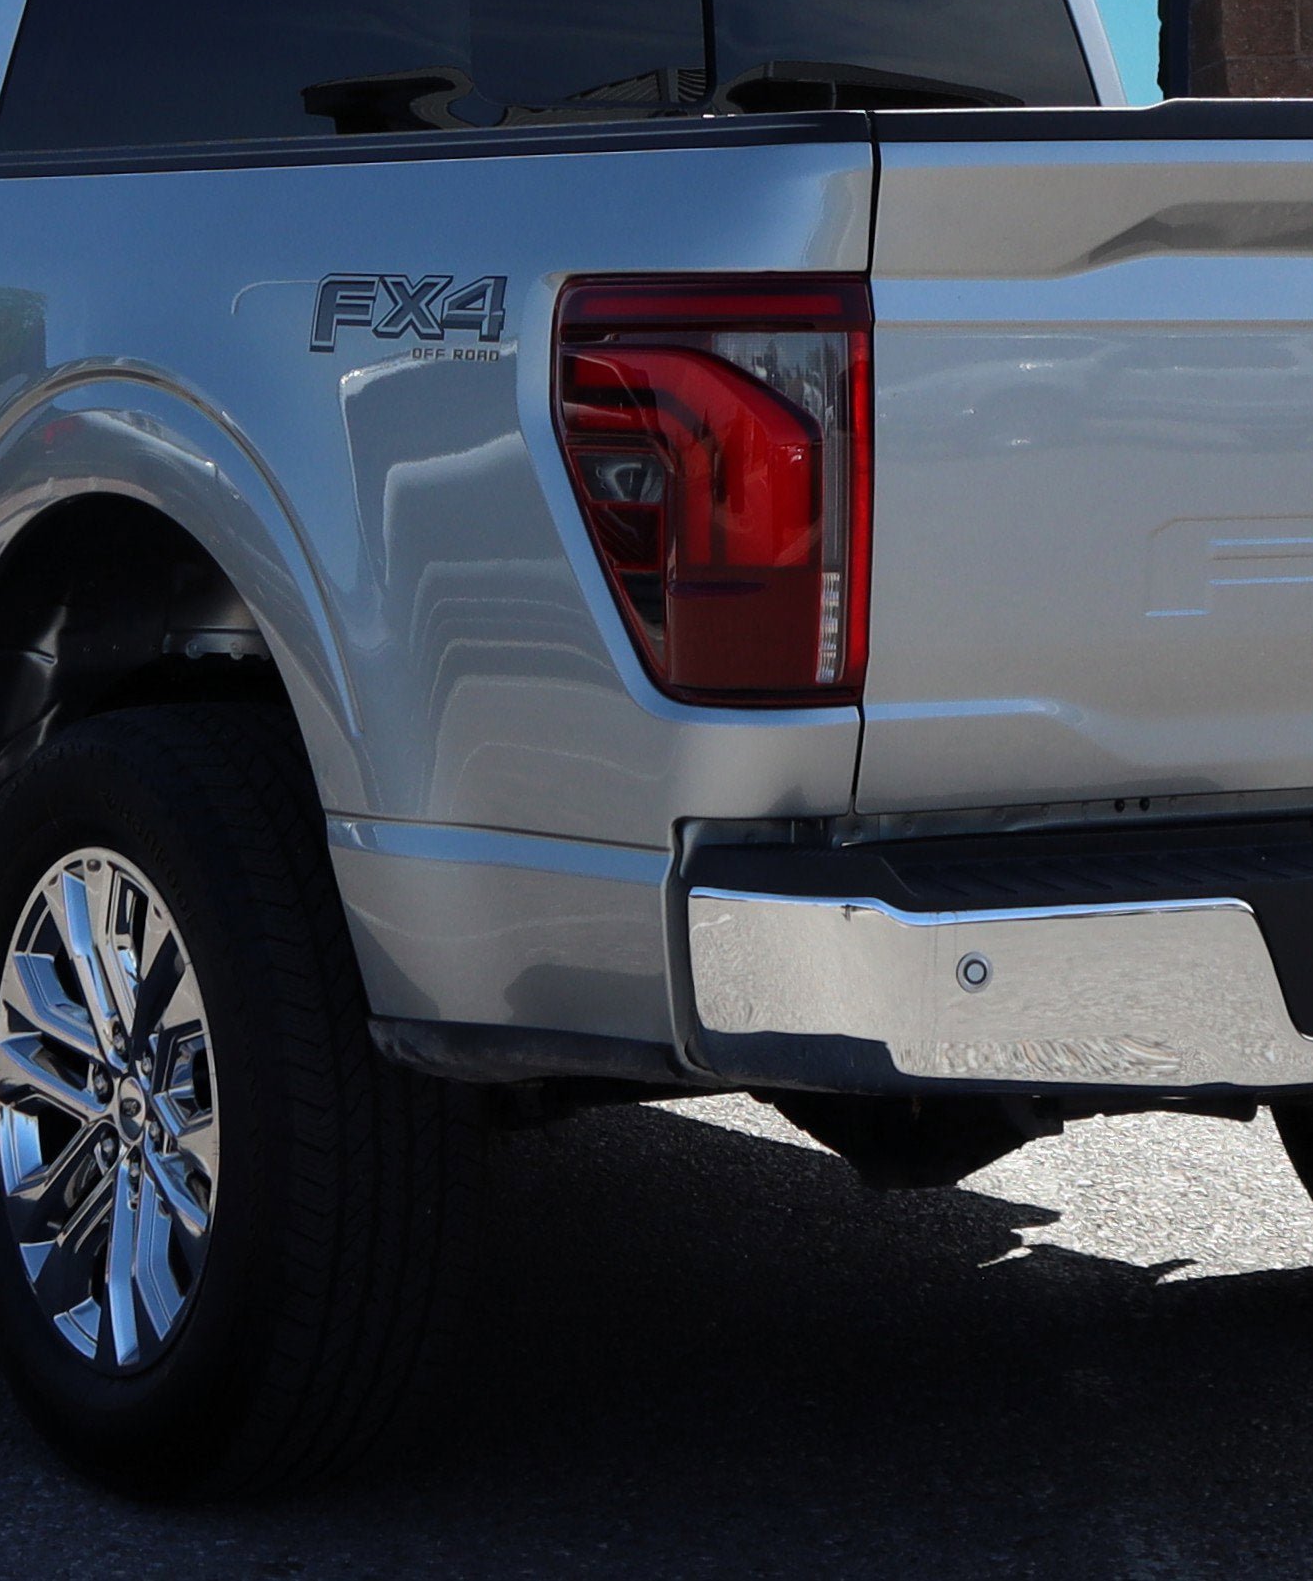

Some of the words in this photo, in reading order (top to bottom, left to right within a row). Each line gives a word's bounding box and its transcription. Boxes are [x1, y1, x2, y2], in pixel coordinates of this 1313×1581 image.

[309, 272, 509, 353] FX4
[412, 347, 445, 360] OFF
[453, 348, 500, 362] ROAD
